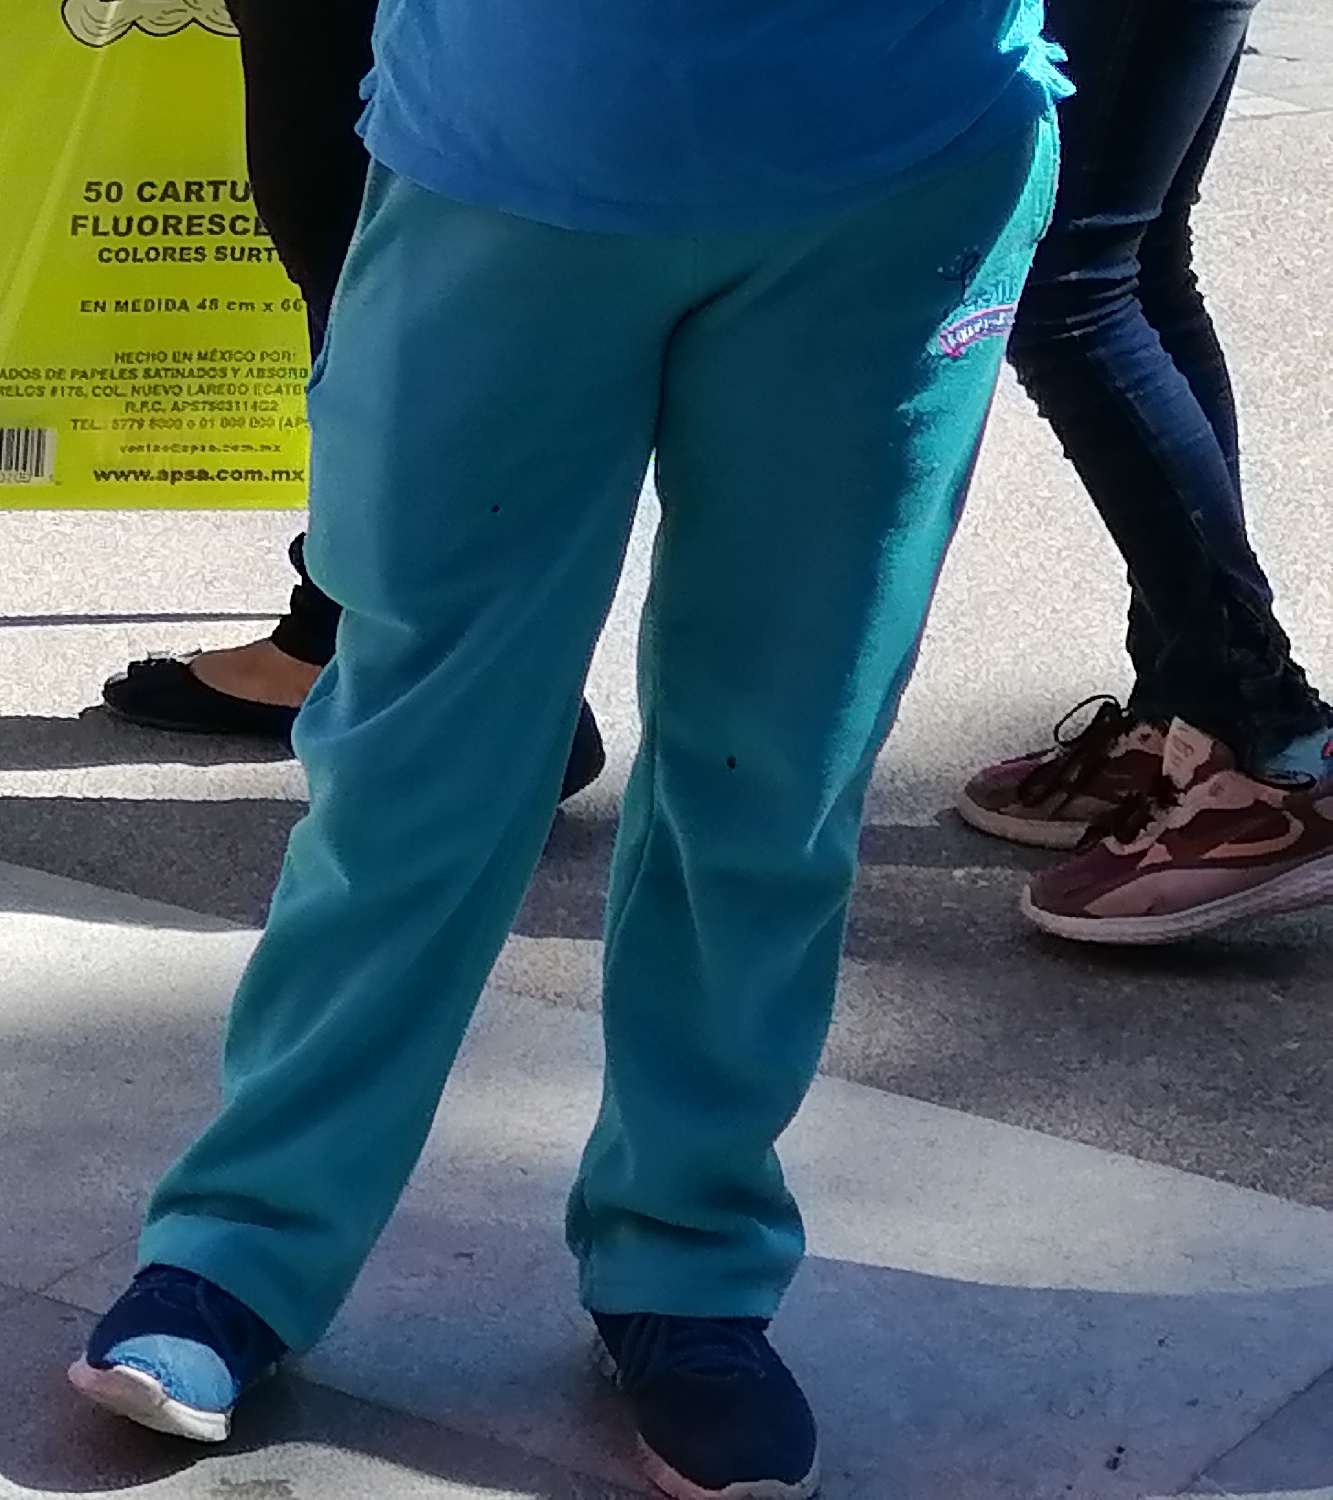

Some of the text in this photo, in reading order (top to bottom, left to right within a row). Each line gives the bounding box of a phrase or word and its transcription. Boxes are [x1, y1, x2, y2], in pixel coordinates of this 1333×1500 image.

[83, 181, 124, 203] 50
[98, 246, 207, 263] COLORES
[80, 300, 107, 313] EN
[114, 299, 190, 313] MEDIDA
[226, 301, 256, 312] cm
[263, 301, 274, 313] x
[114, 350, 168, 364] HECHO
[172, 350, 193, 363] EN
[197, 348, 256, 362] MÉXICO
[45, 367, 67, 381] DE
[71, 367, 138, 380] PAPELES
[143, 366, 228, 379] SATINADOS
[230, 366, 242, 378] Y
[131, 384, 183, 397] NUEVO
[186, 383, 249, 396] LAREDO
[93, 468, 305, 485] www.apsa.com.mx
